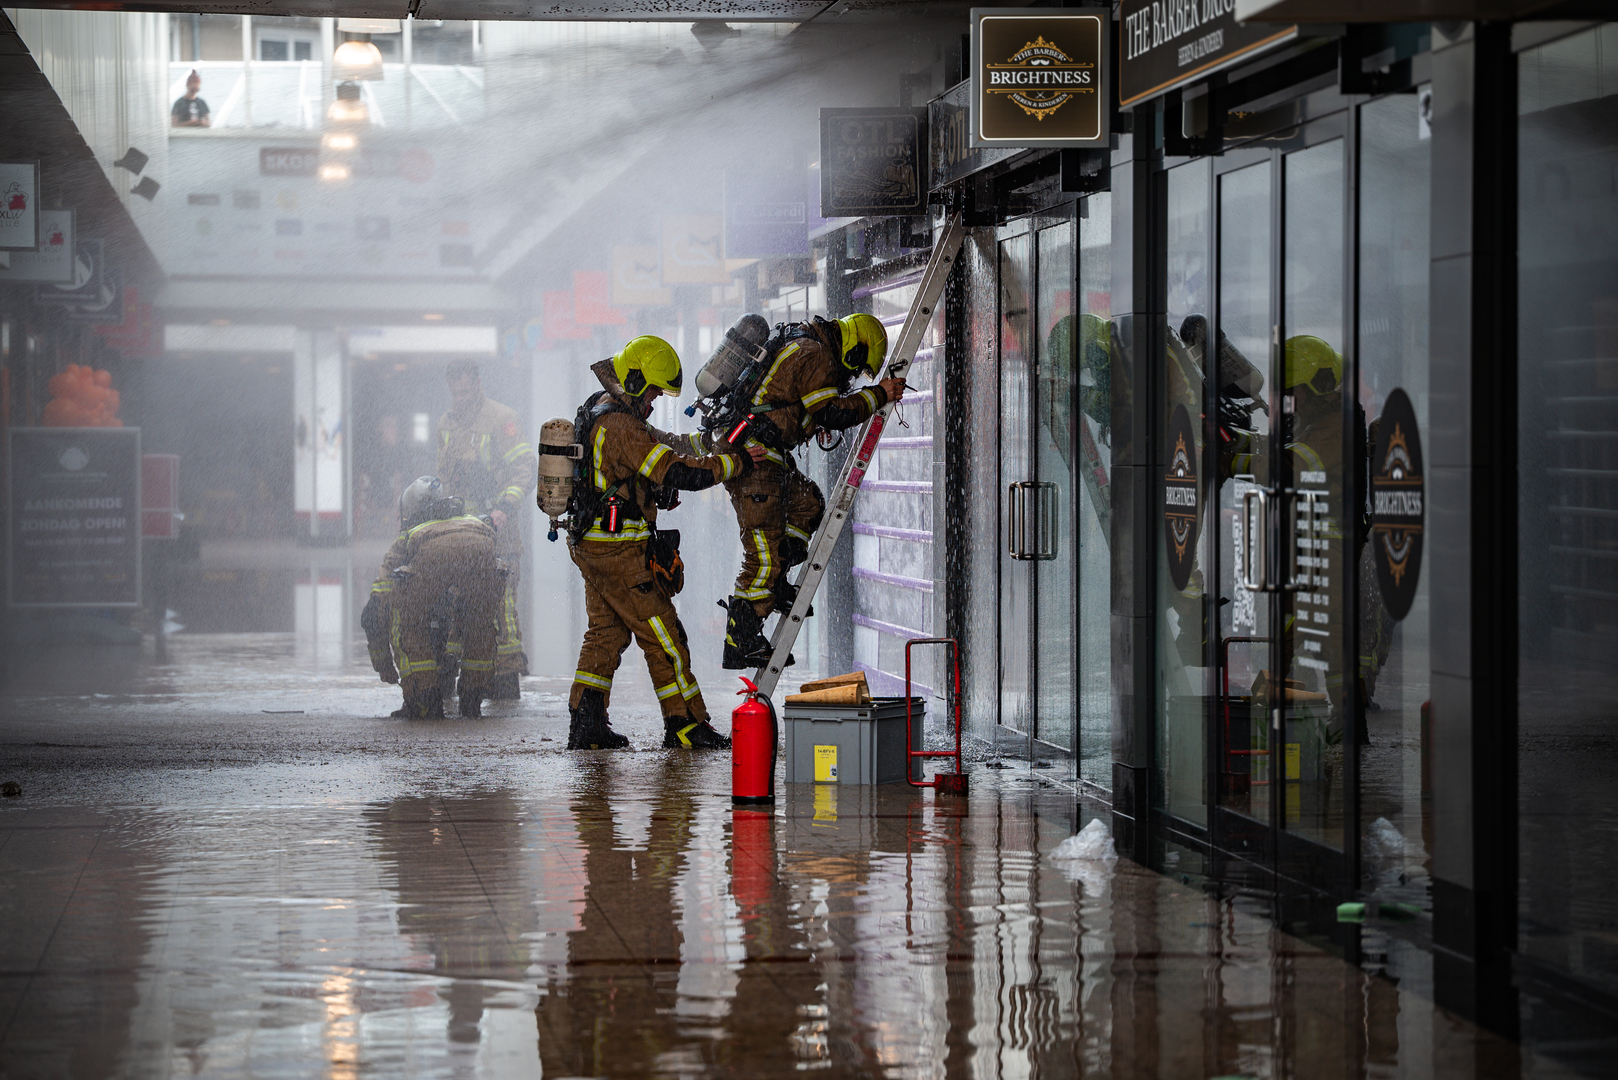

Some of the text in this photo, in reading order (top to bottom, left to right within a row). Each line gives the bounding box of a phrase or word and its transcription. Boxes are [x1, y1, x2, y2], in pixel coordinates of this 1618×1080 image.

[1126, 6, 1150, 60] THE
[1152, 0, 1201, 49] BARBER
[1016, 48, 1065, 61] THE BARBER
[990, 71, 1091, 84] BRIGHTNESS
[1012, 93, 1032, 107] HEREN
[1038, 92, 1068, 107] KINDEREN
[841, 120, 904, 144] OTL
[837, 144, 911, 159] FASHION
[24, 497, 123, 511] AANKOMENDE
[1166, 486, 1197, 507] BRIGHTNESS
[1374, 491, 1422, 516] BRIGHTNESS
[20, 517, 126, 531] ZONDAG OPEN!
